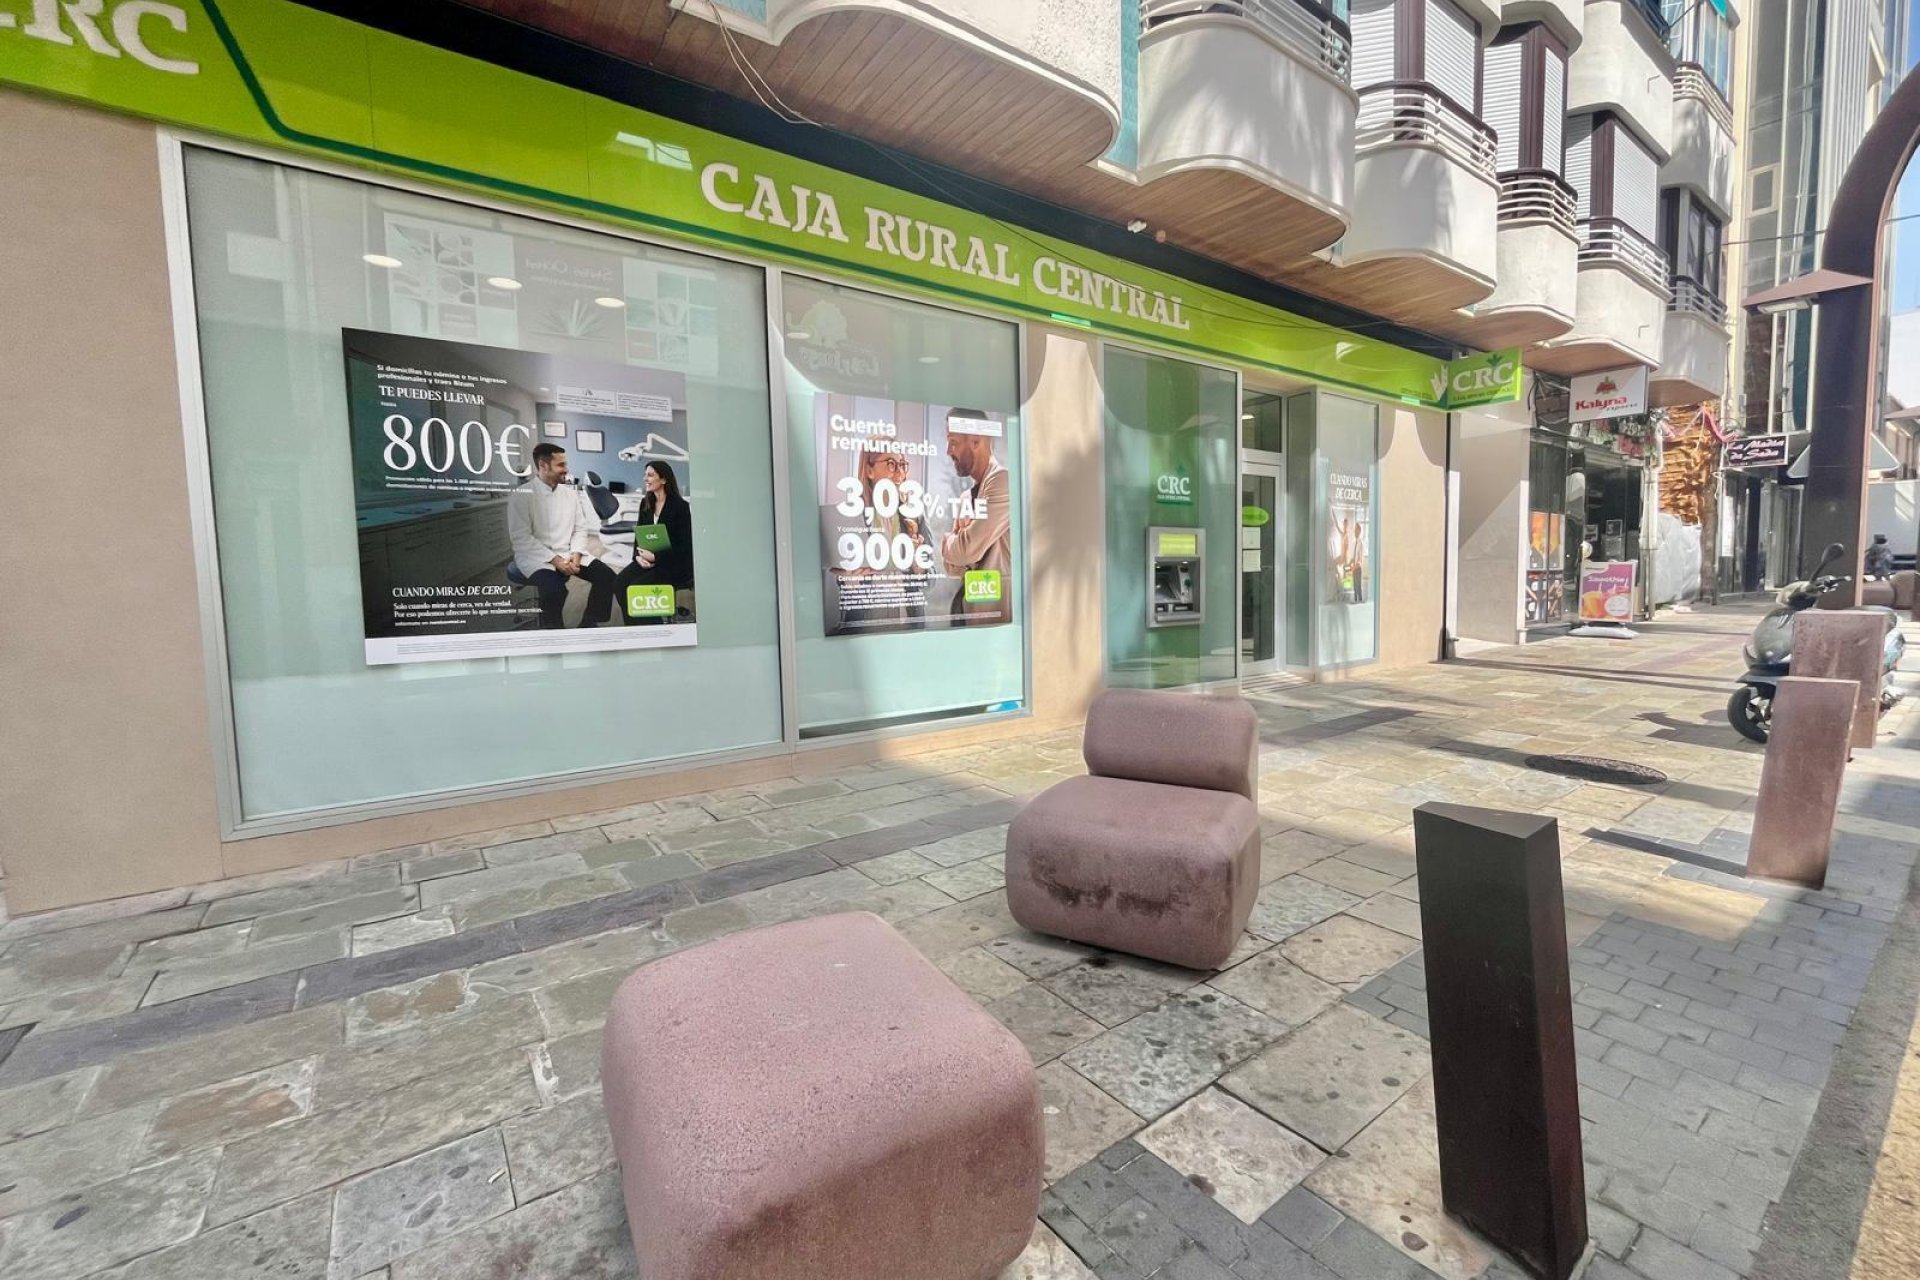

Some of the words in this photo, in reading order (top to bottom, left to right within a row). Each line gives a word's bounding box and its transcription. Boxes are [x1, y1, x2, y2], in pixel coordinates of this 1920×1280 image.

[0, 0, 199, 75] RC
[700, 163, 849, 243] CAJA
[864, 206, 1020, 287] RURAL
[1033, 257, 1191, 330] CENTRAL
[377, 373, 427, 383] profesionales
[385, 365, 423, 376] domicilias
[1453, 362, 1514, 392] CRC
[378, 385, 395, 397] TE
[396, 387, 442, 401] PUEDES
[443, 391, 485, 406] LLEVAR
[830, 414, 897, 437] Cuenta
[383, 414, 533, 477] 800€
[831, 435, 938, 457] remunerada
[1157, 474, 1191, 495] CRC
[836, 476, 945, 525] 3,03%
[948, 497, 989, 521] TAE
[837, 532, 934, 572] 900€
[392, 586, 434, 598] CUANDO
[436, 586, 467, 597] MIRAS
[467, 585, 481, 596] DE
[481, 585, 512, 596] CERCA
[968, 580, 997, 595] CRC
[632, 595, 670, 610] CRC
